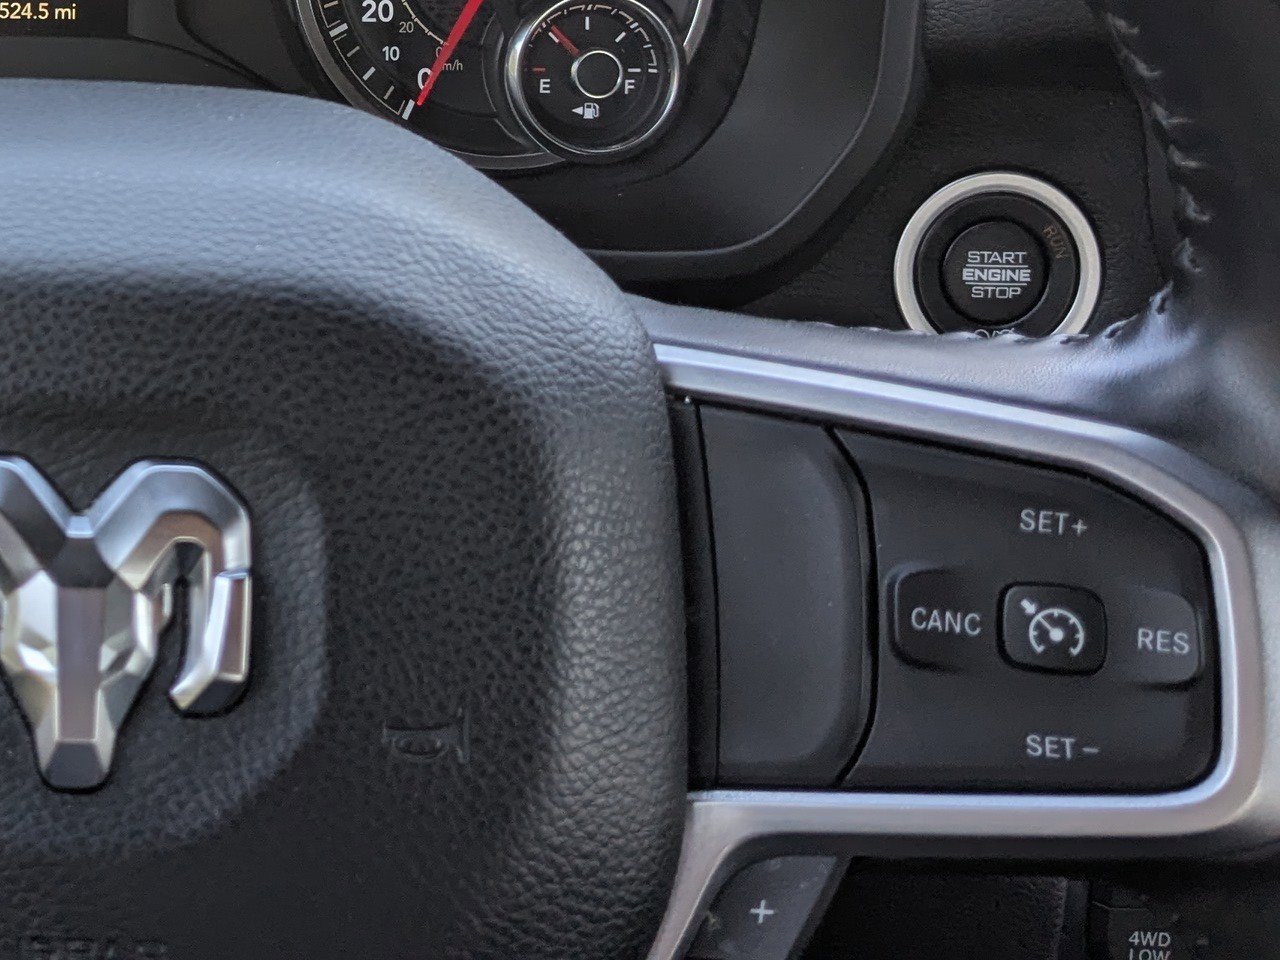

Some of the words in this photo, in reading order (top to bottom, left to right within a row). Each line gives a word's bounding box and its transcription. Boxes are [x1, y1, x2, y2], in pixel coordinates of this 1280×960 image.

[54, 3, 77, 19] mi
[361, 0, 394, 23] 20
[398, 21, 414, 34] 20
[381, 45, 400, 61] 10
[539, 79, 551, 95] E
[624, 81, 636, 95] F
[967, 251, 1027, 264] START
[962, 269, 1031, 282] ENGINE
[971, 287, 1021, 299] STOP
[911, 607, 981, 635] CANC
[1137, 627, 1189, 655] RES
[1128, 931, 1171, 947] 4WD
[1129, 948, 1170, 960] LOW
